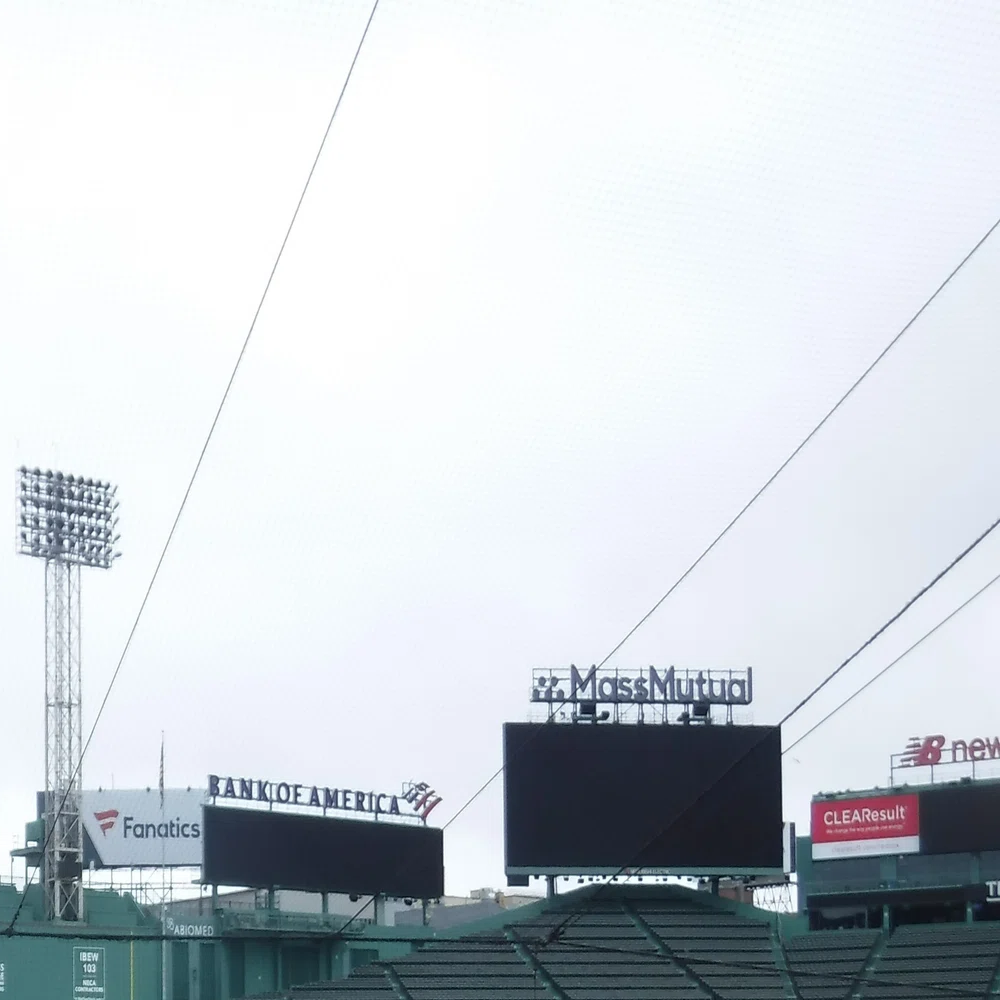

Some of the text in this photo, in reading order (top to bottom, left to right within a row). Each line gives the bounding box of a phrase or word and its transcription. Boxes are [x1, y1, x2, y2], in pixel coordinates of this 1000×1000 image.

[571, 664, 752, 701] MassMutual
[208, 775, 401, 815] BANK OF AMERICA
[824, 805, 906, 826] CLEAResult
[123, 816, 200, 839] Fanatics
[174, 924, 214, 937] ABIOMED
[79, 952, 99, 962] IBEW
[82, 963, 96, 973] 103
